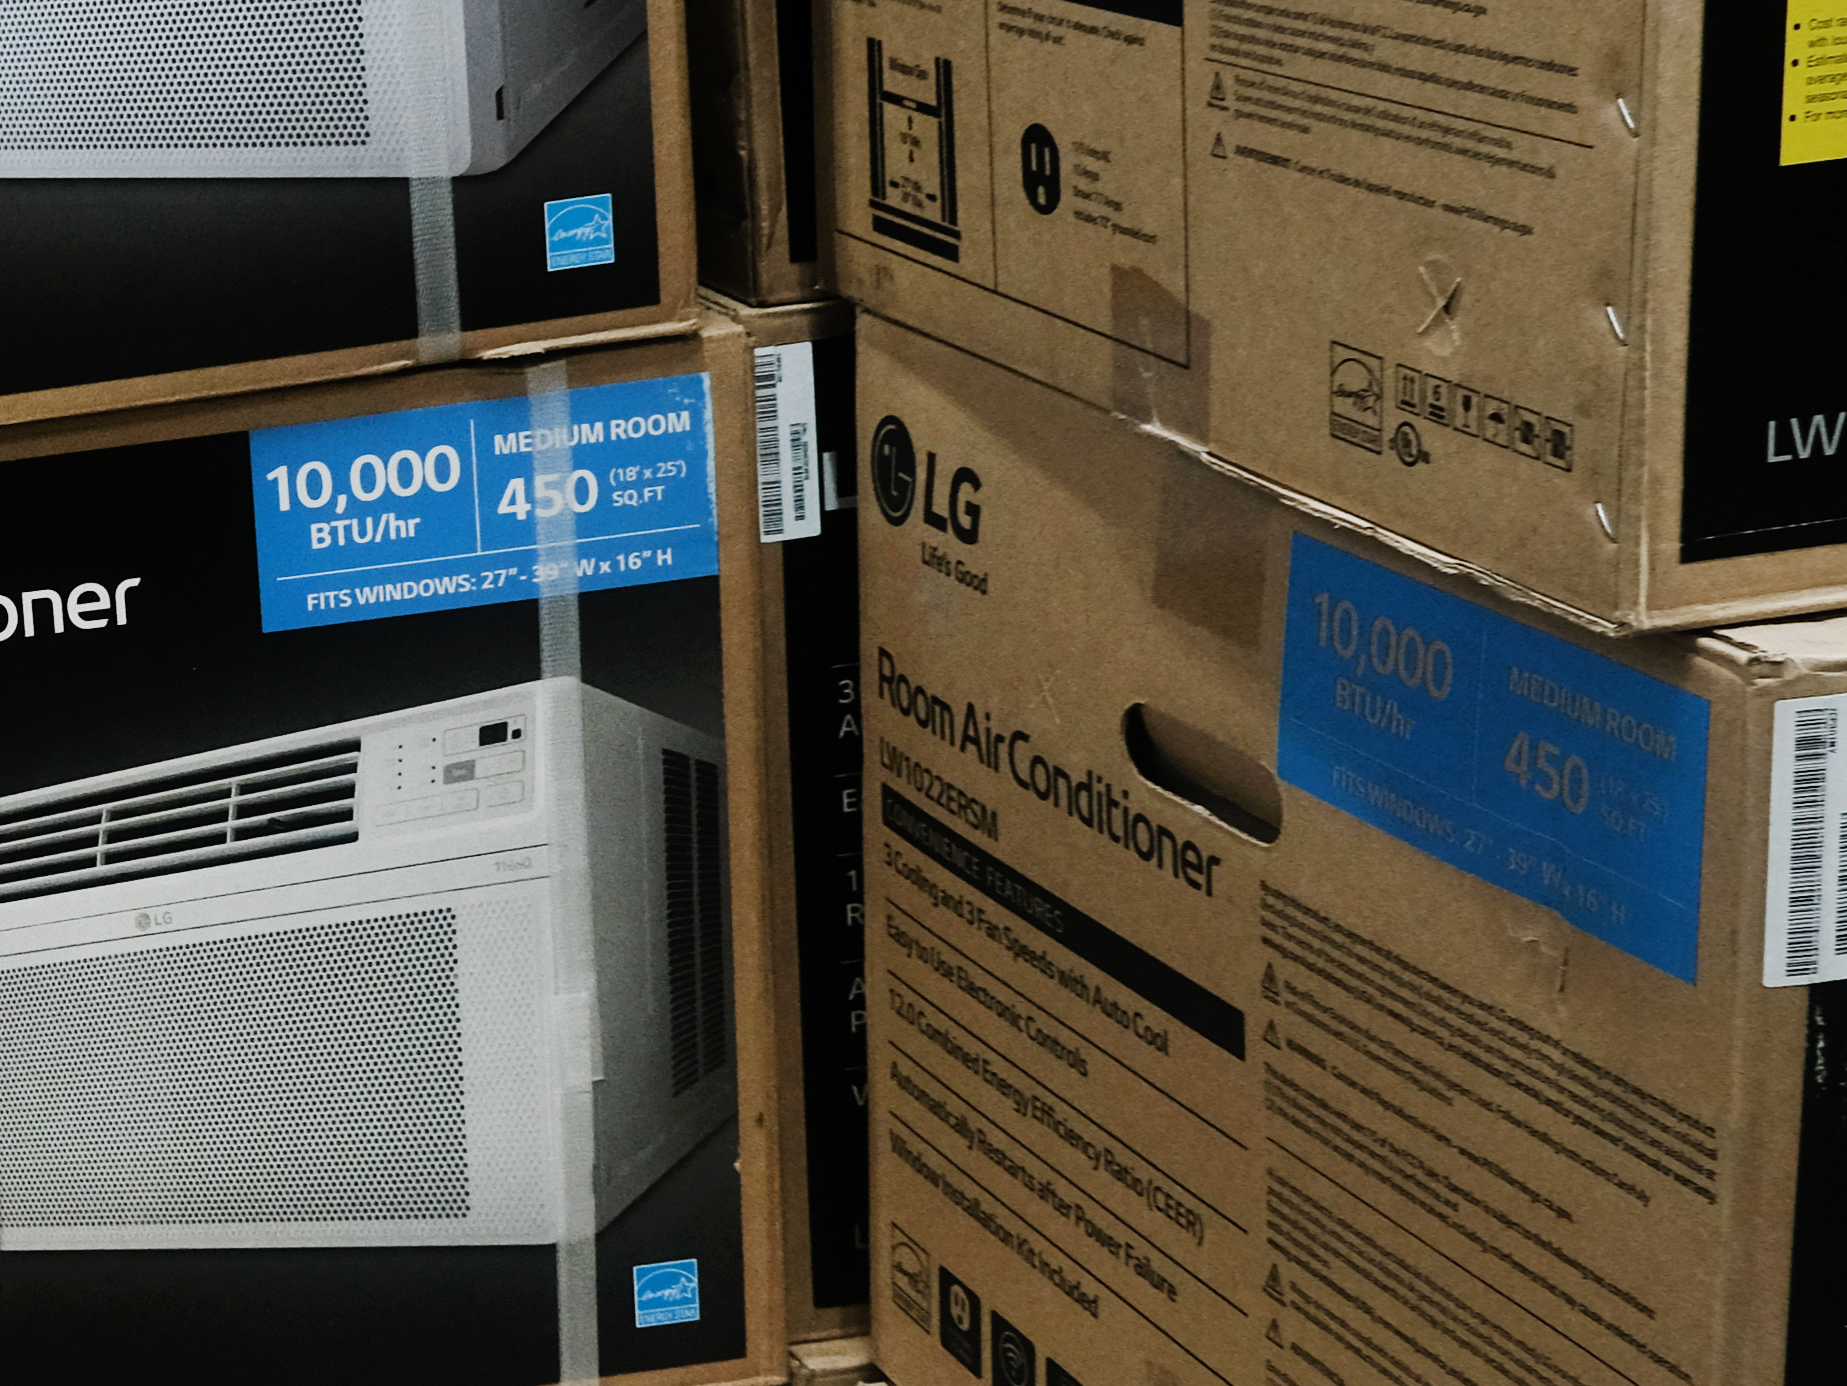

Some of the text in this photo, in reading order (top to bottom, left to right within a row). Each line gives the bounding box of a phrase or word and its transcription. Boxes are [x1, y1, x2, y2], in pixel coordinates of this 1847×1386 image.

[494, 410, 691, 455] MEDIUM ROOM
[266, 444, 461, 514] 10,000
[497, 469, 599, 520] 450
[922, 450, 983, 545] LG
[310, 512, 421, 550] BTU/hr
[921, 541, 988, 596] Life's Good
[1314, 591, 1454, 702] 10,000
[879, 735, 1001, 842] LW1022ERSM
[1503, 732, 1591, 815] 450
